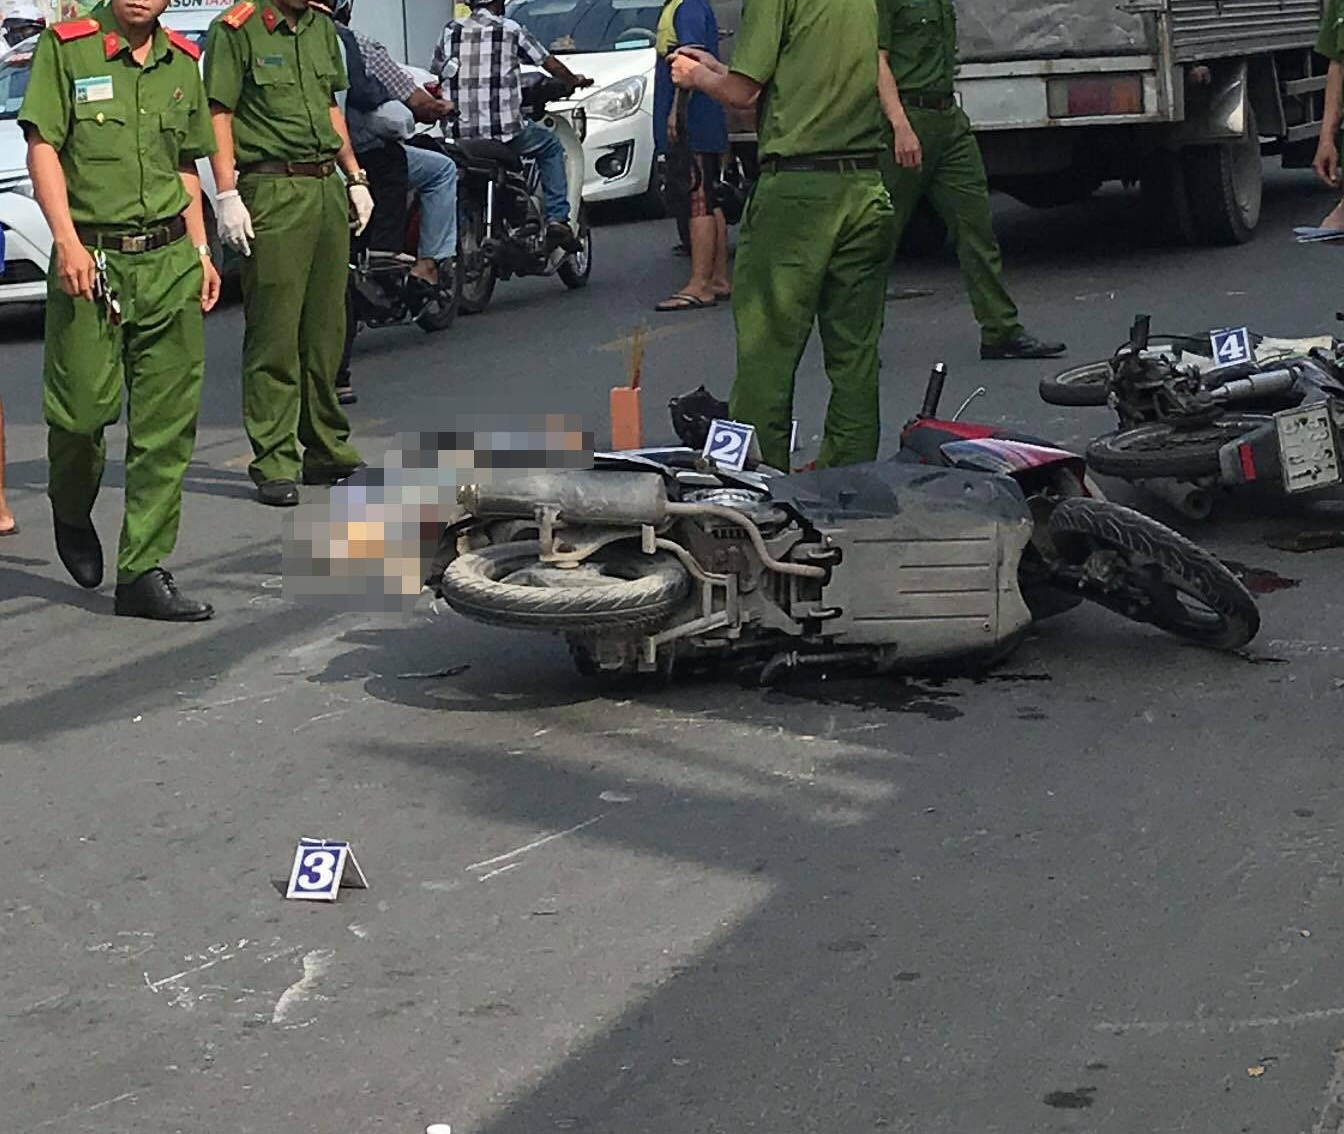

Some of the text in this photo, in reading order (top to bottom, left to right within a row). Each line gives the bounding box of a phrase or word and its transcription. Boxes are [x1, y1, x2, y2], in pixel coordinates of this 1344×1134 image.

[1218, 334, 1244, 360] 4
[709, 430, 742, 463] 2
[297, 850, 336, 891] 3
